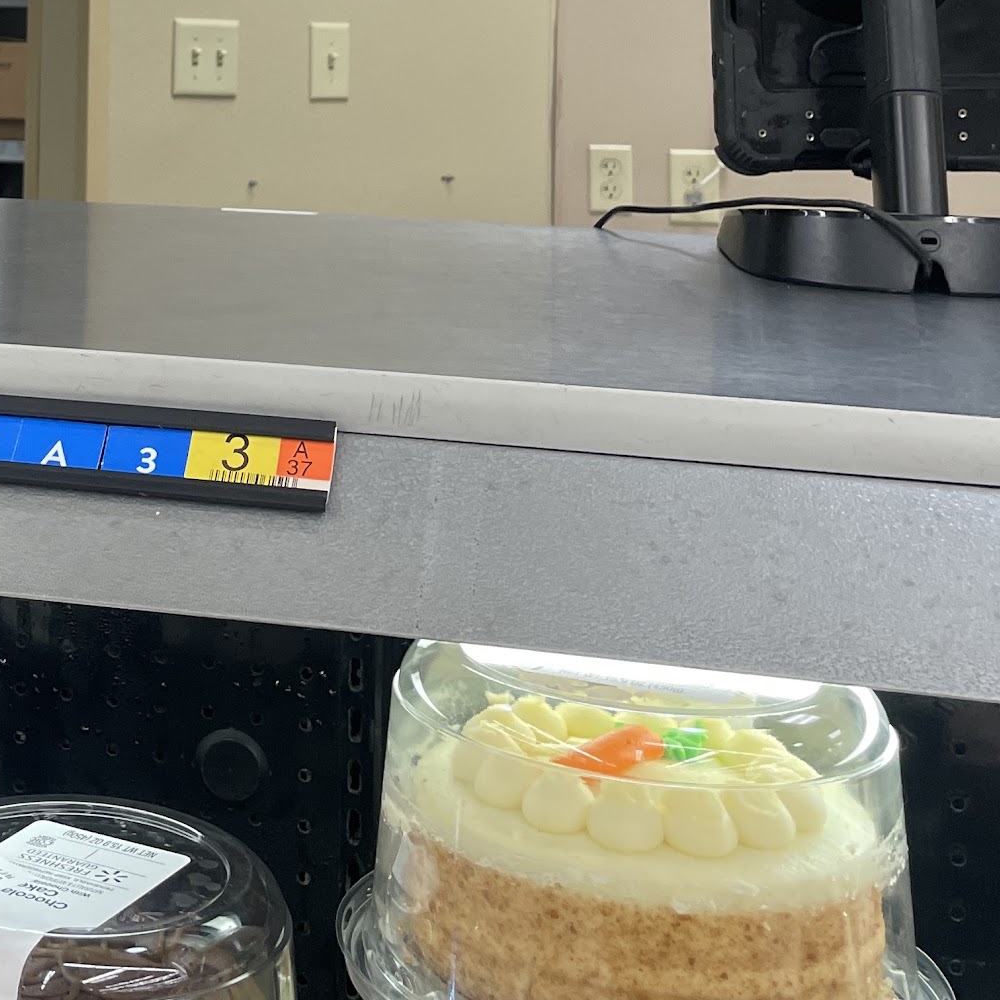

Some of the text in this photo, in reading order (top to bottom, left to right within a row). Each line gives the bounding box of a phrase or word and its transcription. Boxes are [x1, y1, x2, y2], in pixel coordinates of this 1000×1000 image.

[41, 440, 67, 467] A
[136, 447, 157, 473] 3
[221, 433, 250, 472] 3
[292, 441, 309, 459] A
[286, 460, 312, 477] 37
[63, 829, 92, 844] (450g)
[89, 836, 104, 846] OZ
[104, 840, 123, 852] 15.9
[124, 845, 139, 854] WT
[140, 849, 158, 858] NET
[18, 853, 91, 876] FRESHNESS
[27, 848, 98, 871] GUARANTEED
[16, 881, 59, 897] Cake
[32, 879, 70, 894] Chocola
[1, 886, 68, 911] Chocola
